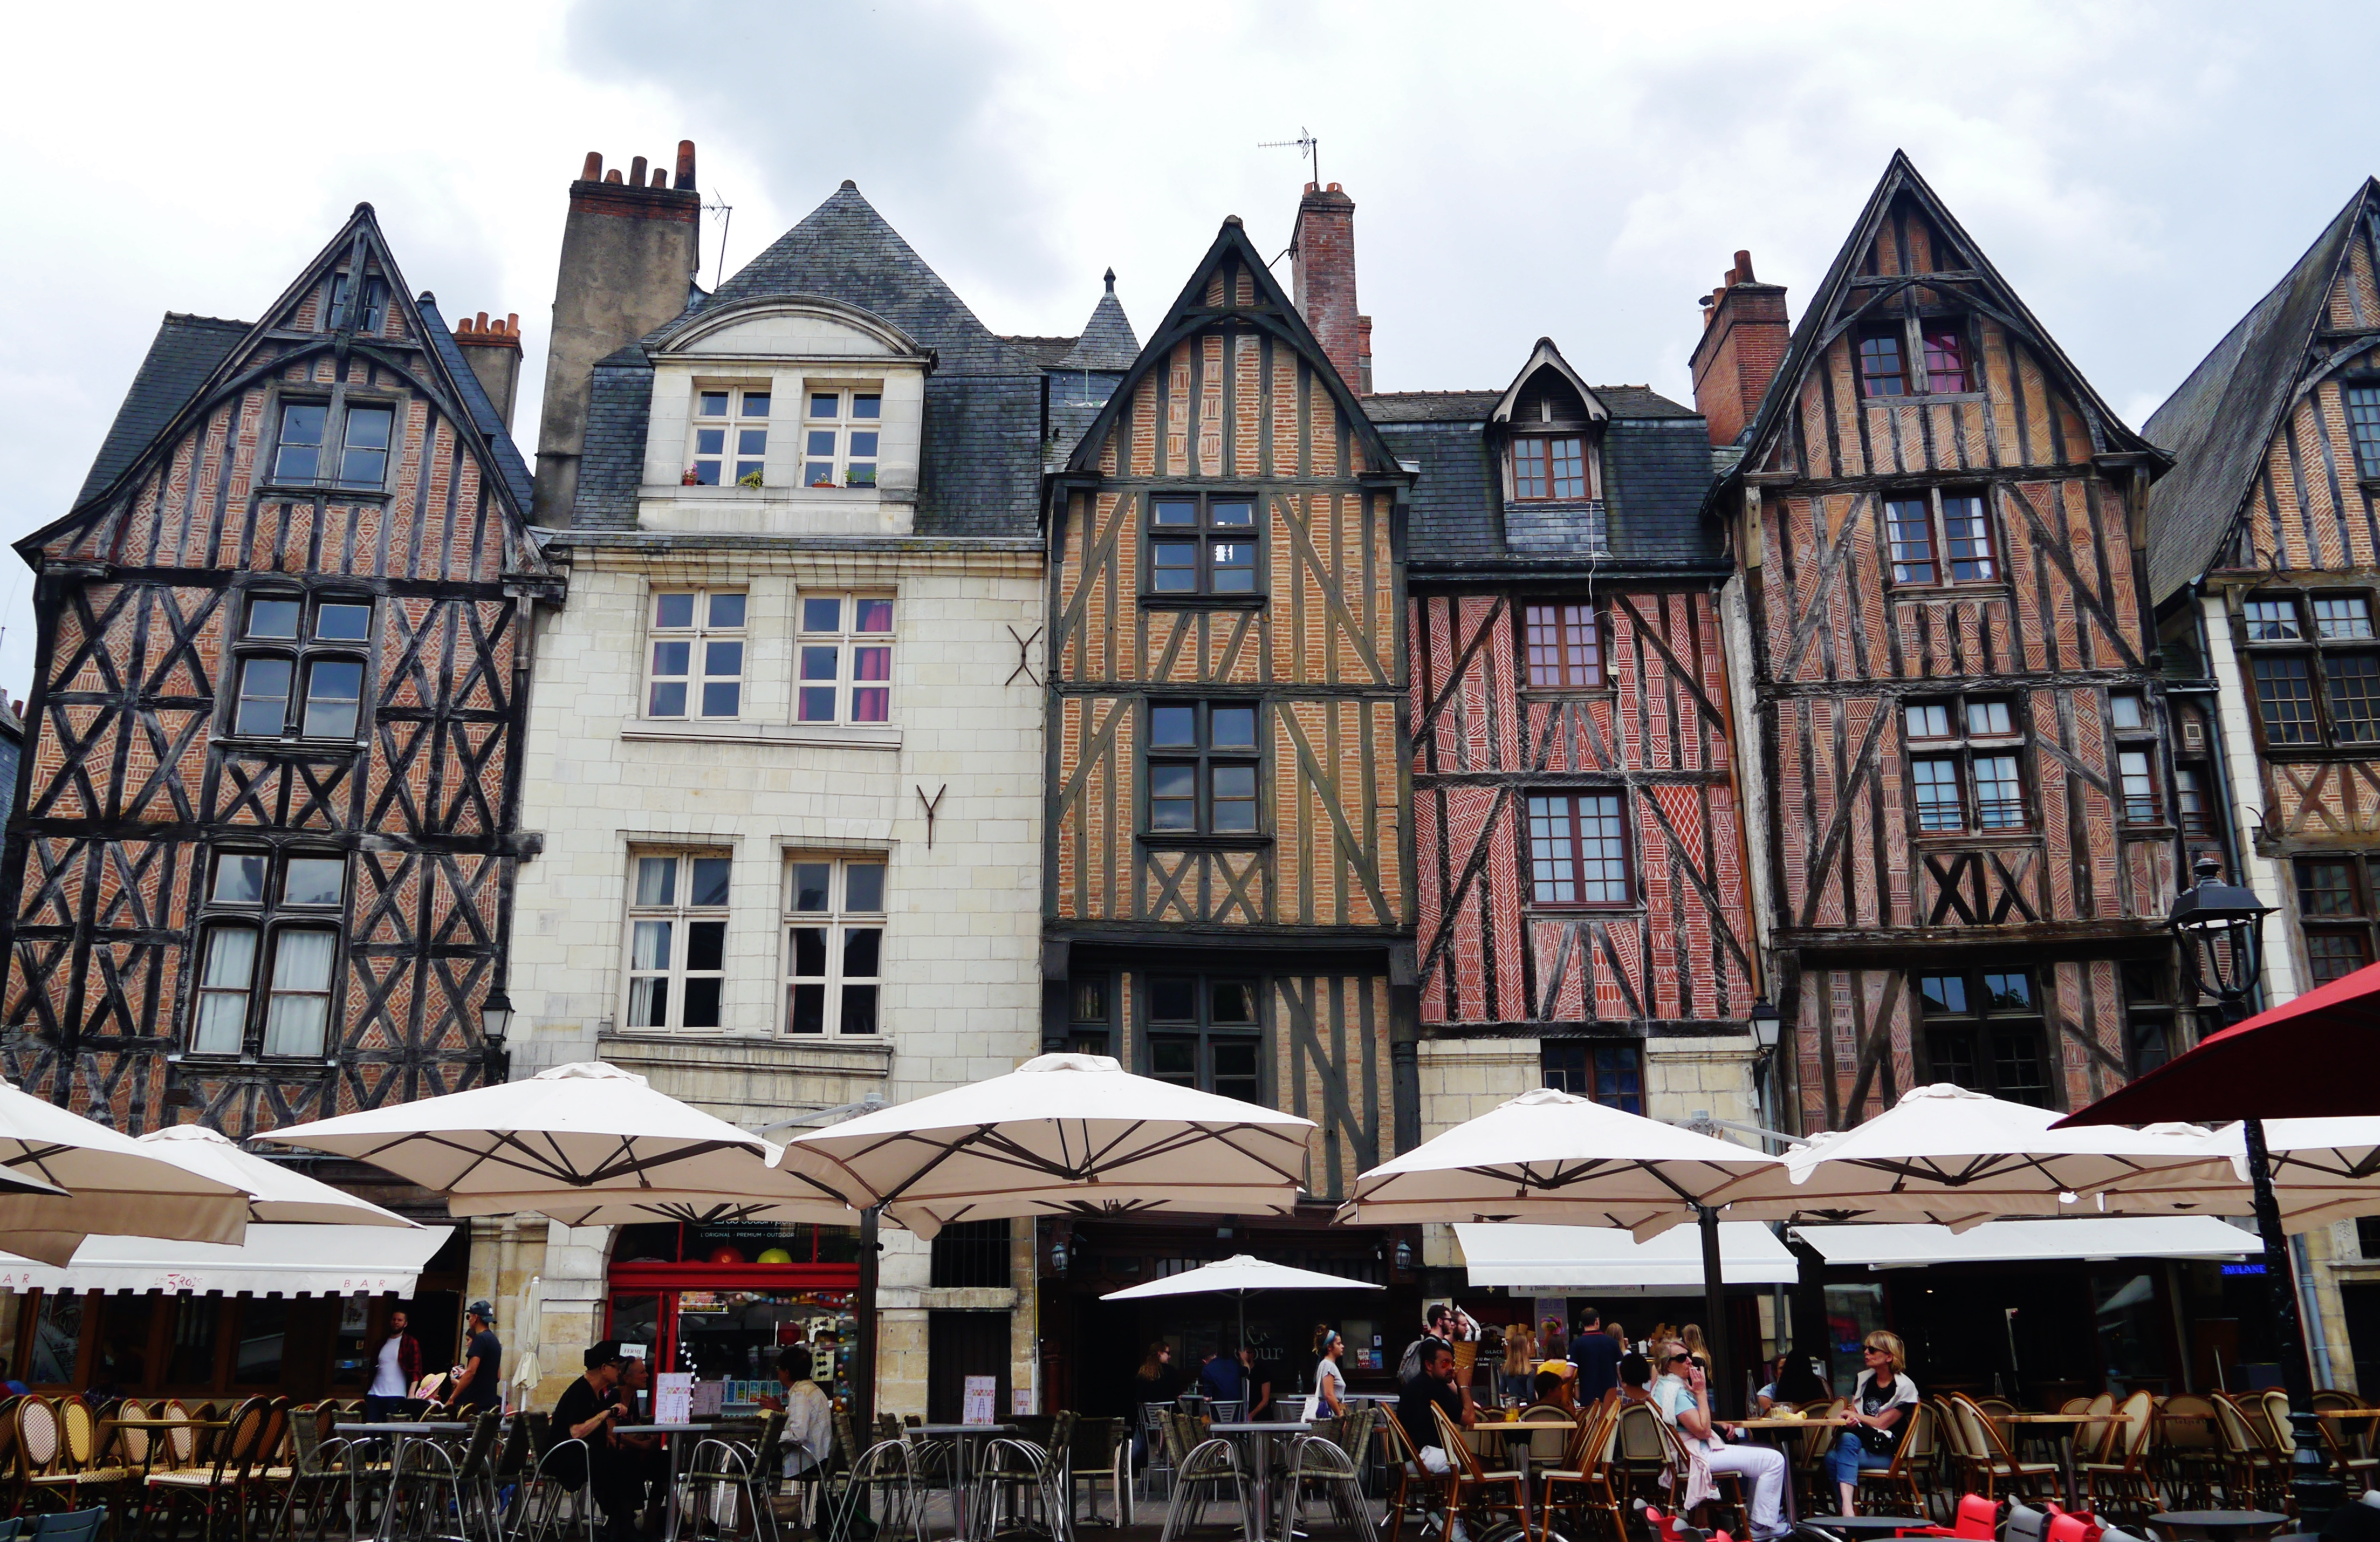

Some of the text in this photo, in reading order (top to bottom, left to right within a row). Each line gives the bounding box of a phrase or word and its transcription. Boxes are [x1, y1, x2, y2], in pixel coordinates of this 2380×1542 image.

[2221, 1264, 2267, 1274] PAULANE
[166, 1273, 180, 1293] 3
[344, 1279, 386, 1288] BAR
